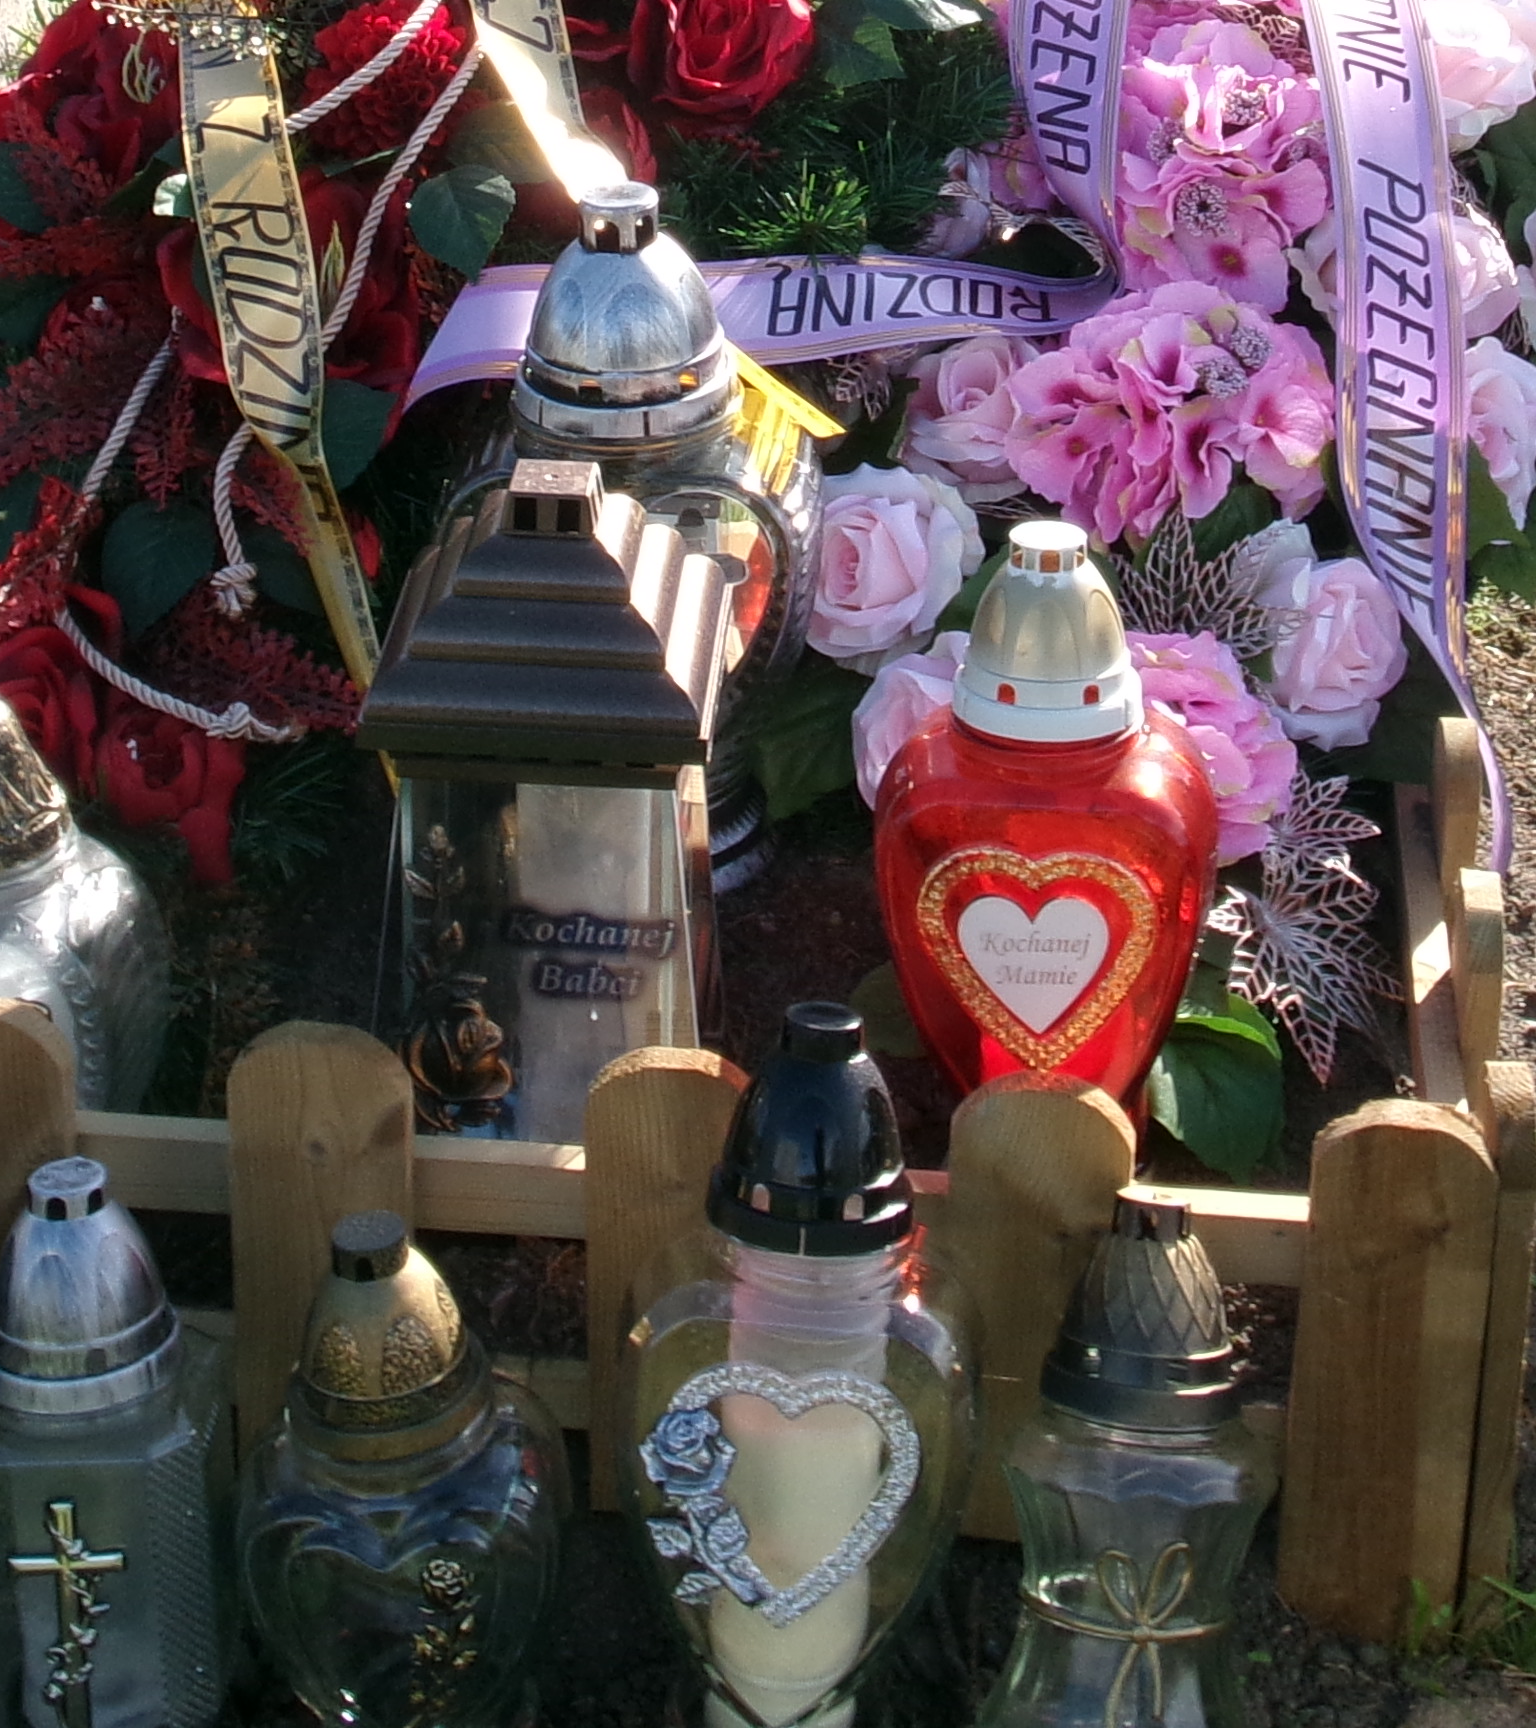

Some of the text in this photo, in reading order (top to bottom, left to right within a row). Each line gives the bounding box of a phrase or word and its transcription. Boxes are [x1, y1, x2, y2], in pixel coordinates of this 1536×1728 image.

[506, 915, 676, 960] Kochanej
[979, 930, 1092, 960] Kochanej
[537, 960, 641, 998] Babci
[995, 964, 1079, 985] Mamie
